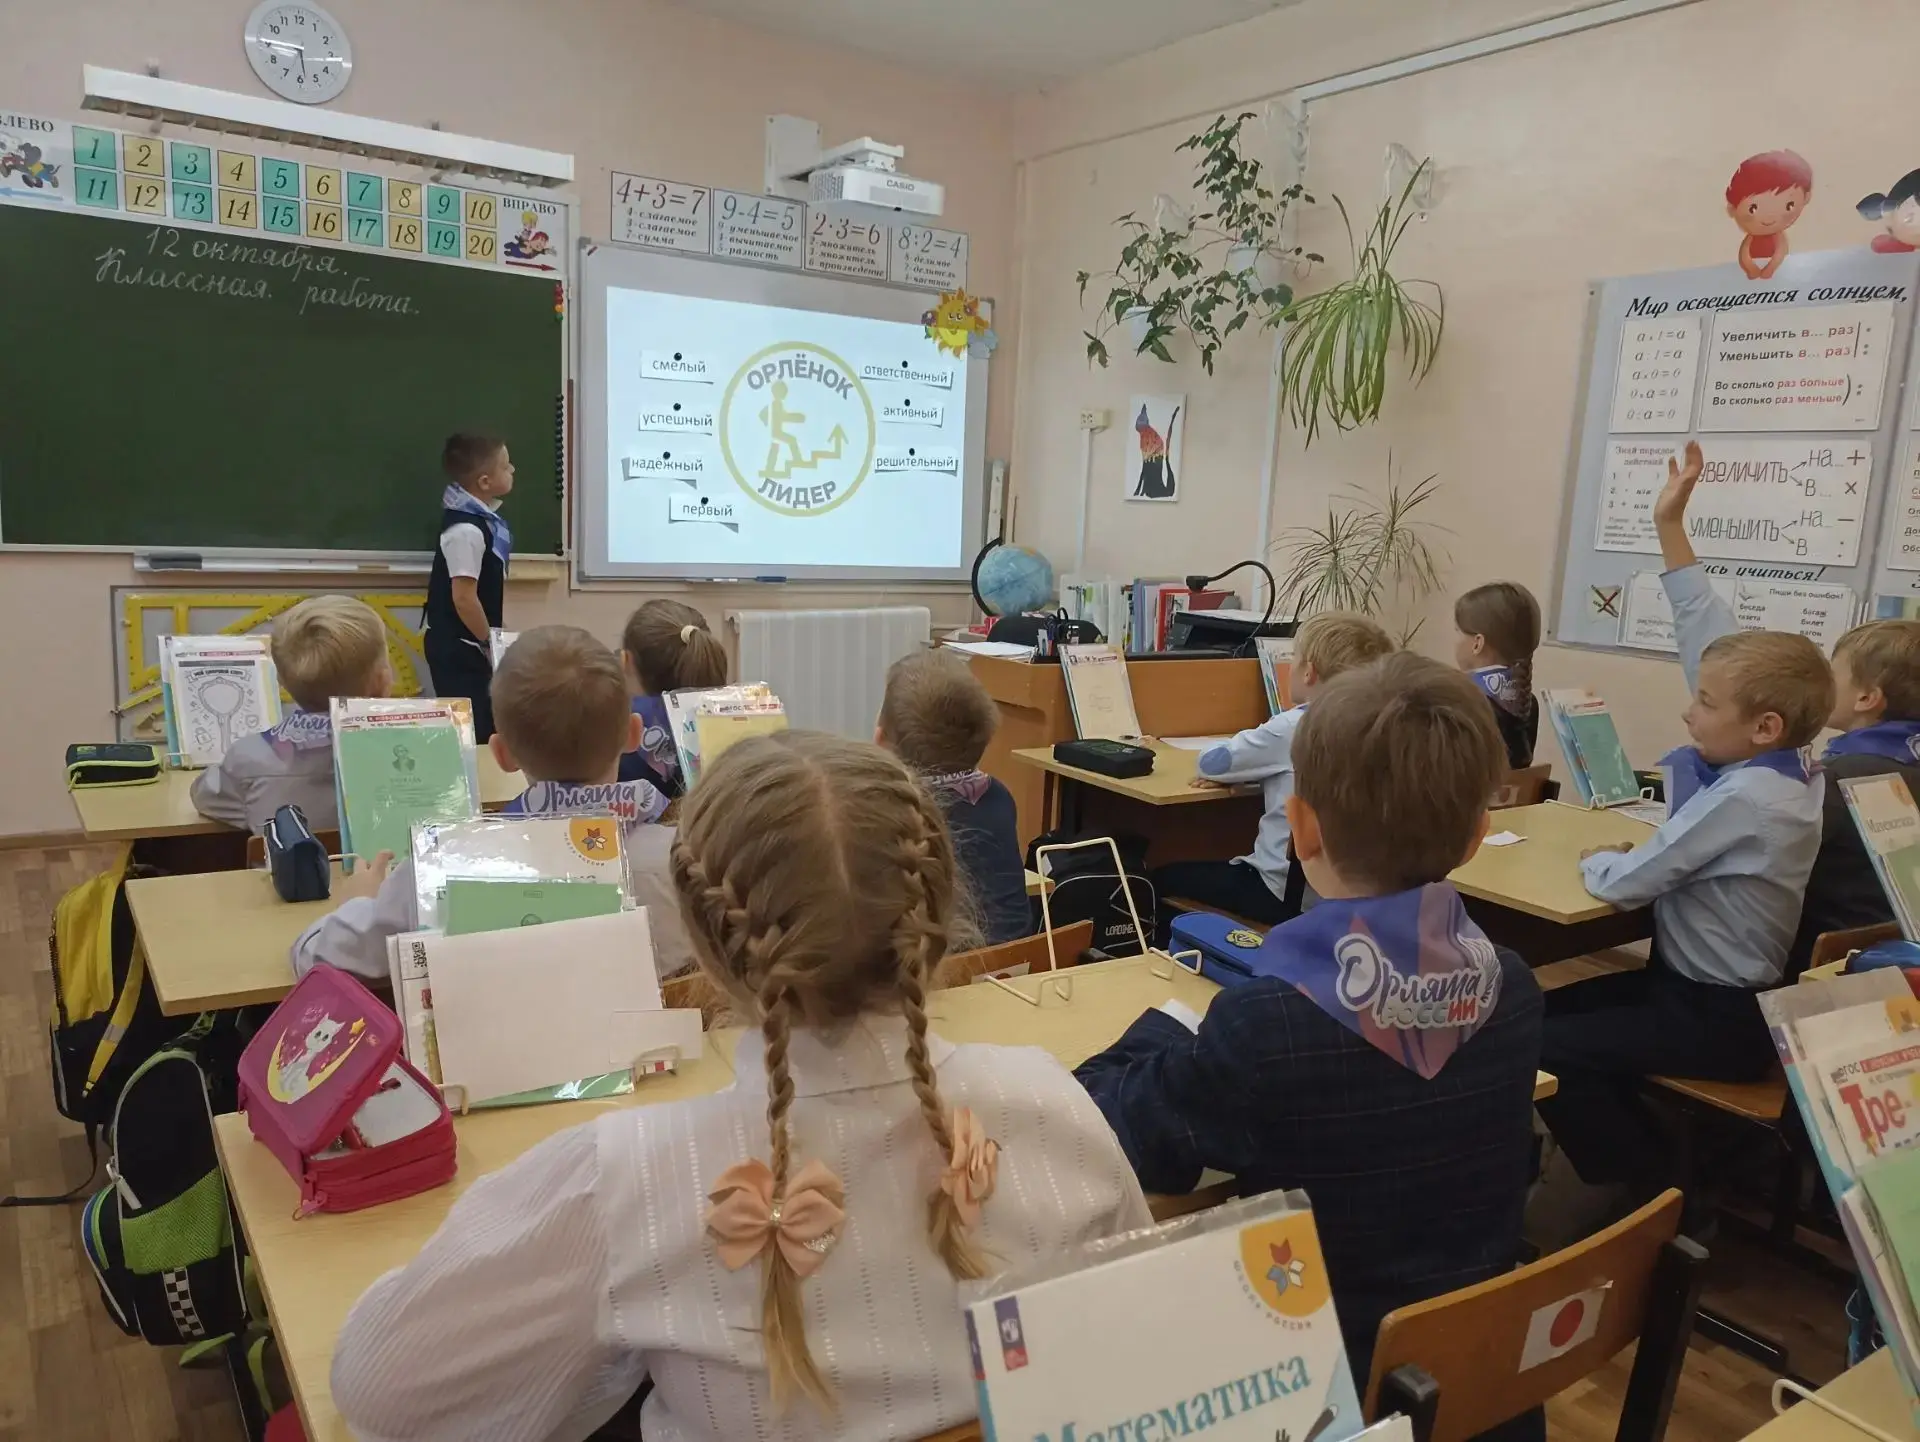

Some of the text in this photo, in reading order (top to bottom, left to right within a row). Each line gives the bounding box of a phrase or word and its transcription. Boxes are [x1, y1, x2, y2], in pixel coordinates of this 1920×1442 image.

[280, 16, 288, 26] 11
[294, 15, 305, 25] 12
[269, 25, 280, 34] 10
[322, 36, 329, 44] 2
[270, 55, 277, 64] 8
[283, 68, 289, 77] 7
[322, 66, 329, 74] 4
[297, 75, 304, 84] 6
[313, 74, 319, 82] 5
[91, 138, 492, 221] 1 2 3 4 5 6 7 8 9 10
[886, 179, 915, 192] CASIO
[502, 197, 557, 216] ВПРАВО
[87, 179, 494, 256] 11 12 13 14 15 16 17 18 19 20
[639, 211, 698, 226] слагаемое
[638, 223, 697, 237] слагаемое
[729, 225, 799, 242] уменьшаемое
[638, 234, 675, 245] сумма
[729, 236, 793, 252] вычитаемое
[146, 226, 347, 282] 12 октября.
[728, 248, 779, 260] разность
[820, 241, 876, 254] множитель
[819, 251, 876, 265] множитель
[914, 255, 951, 267] делимое
[819, 261, 884, 277] произведение
[1625, 284, 1908, 318] Мир освещается солнцем,
[1722, 329, 1796, 343] Увеличить
[1828, 325, 1854, 339] раз
[1719, 350, 1793, 362] Уменьшить
[1825, 347, 1851, 358] раз
[652, 359, 707, 374] смелый
[864, 364, 948, 384] ответственный
[746, 353, 855, 400] ОРЛЁНОК
[1715, 378, 1844, 391] Во сколько раз больше
[1712, 395, 1842, 406] Во сколько раз меньше
[642, 412, 713, 427] успешный
[882, 405, 938, 420] активный
[631, 457, 703, 472] надёжный
[876, 453, 954, 470] решительный
[757, 477, 837, 509] ЛИДЕР
[682, 503, 733, 518] первый
[1736, 566, 1827, 582] учиться!
[1769, 588, 1792, 596] Пиши
[1800, 619, 1824, 627] билет
[523, 781, 636, 816] Орлята
[1337, 938, 1481, 1015] Орлята
[1032, 1354, 1312, 1442] Мтематика
